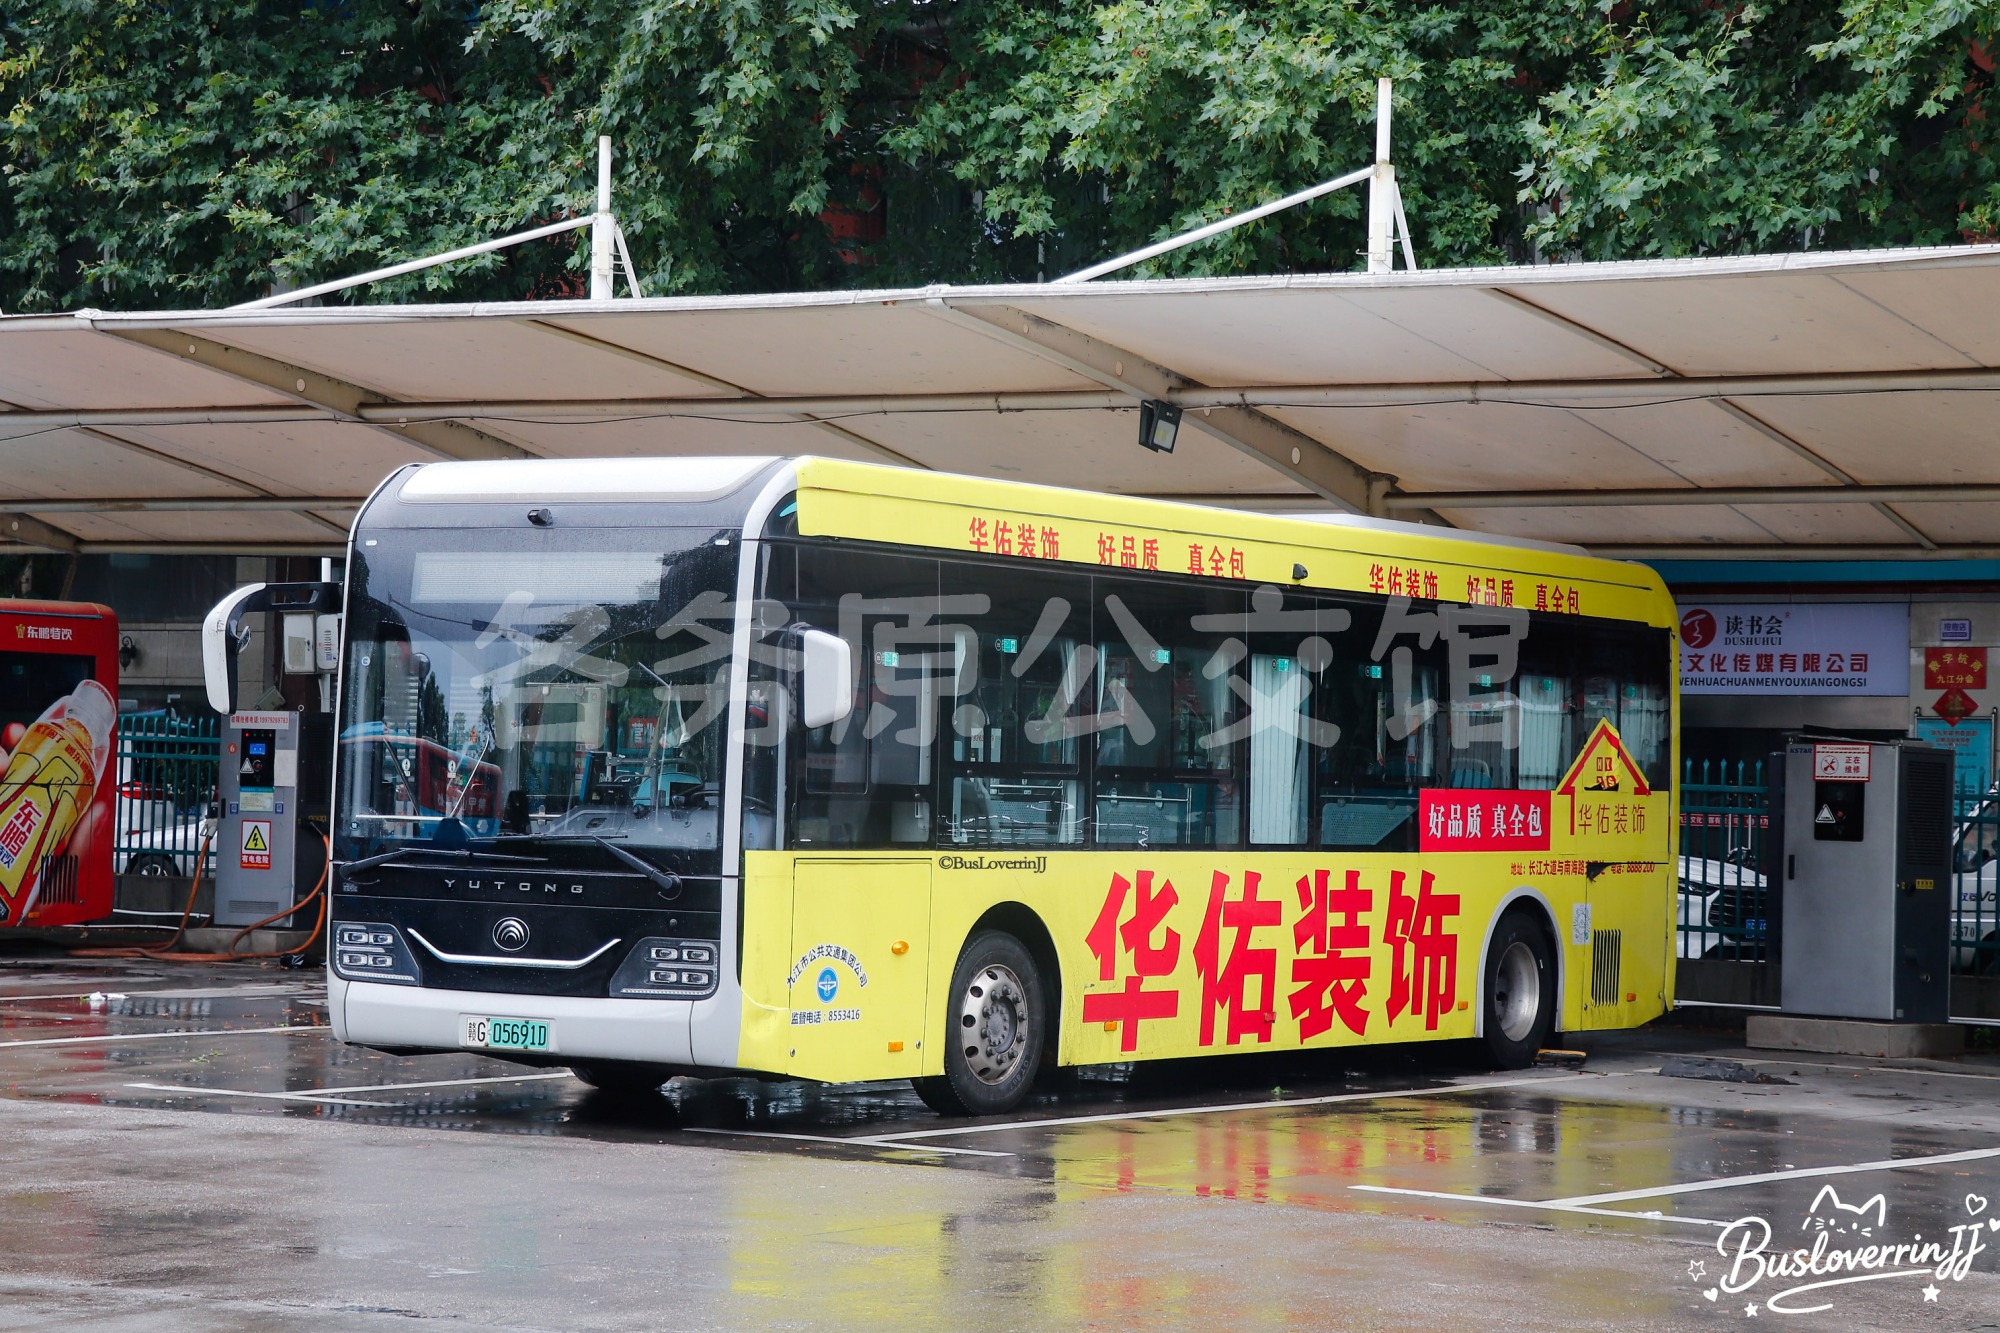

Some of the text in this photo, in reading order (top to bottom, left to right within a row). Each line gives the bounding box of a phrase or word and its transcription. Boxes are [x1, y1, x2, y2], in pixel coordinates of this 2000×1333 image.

[969, 516, 1246, 580] 华佑装饰 好品质 真全包
[1369, 563, 1580, 616] 华佑装饰 好品质 真全包
[27, 626, 73, 641] 东鹏特饮
[1725, 615, 1783, 636] 读书会
[1724, 637, 1782, 646] DUSHUHUI
[1679, 653, 1868, 673] 文化传媒有限公司
[1936, 674, 1974, 684] 九江分会
[1845, 756, 1861, 764] 正在
[1845, 766, 1861, 774] 维修
[0, 799, 42, 858] 东鹏
[1428, 803, 1543, 838] 好品质 真全包
[1578, 803, 1645, 835] 华佑装饰
[241, 855, 269, 864] 有电危险
[444, 879, 584, 894] YUTONG
[786, 944, 868, 990] 九江市公共交通集团公司
[1082, 869, 1461, 1053] 华佑装饰
